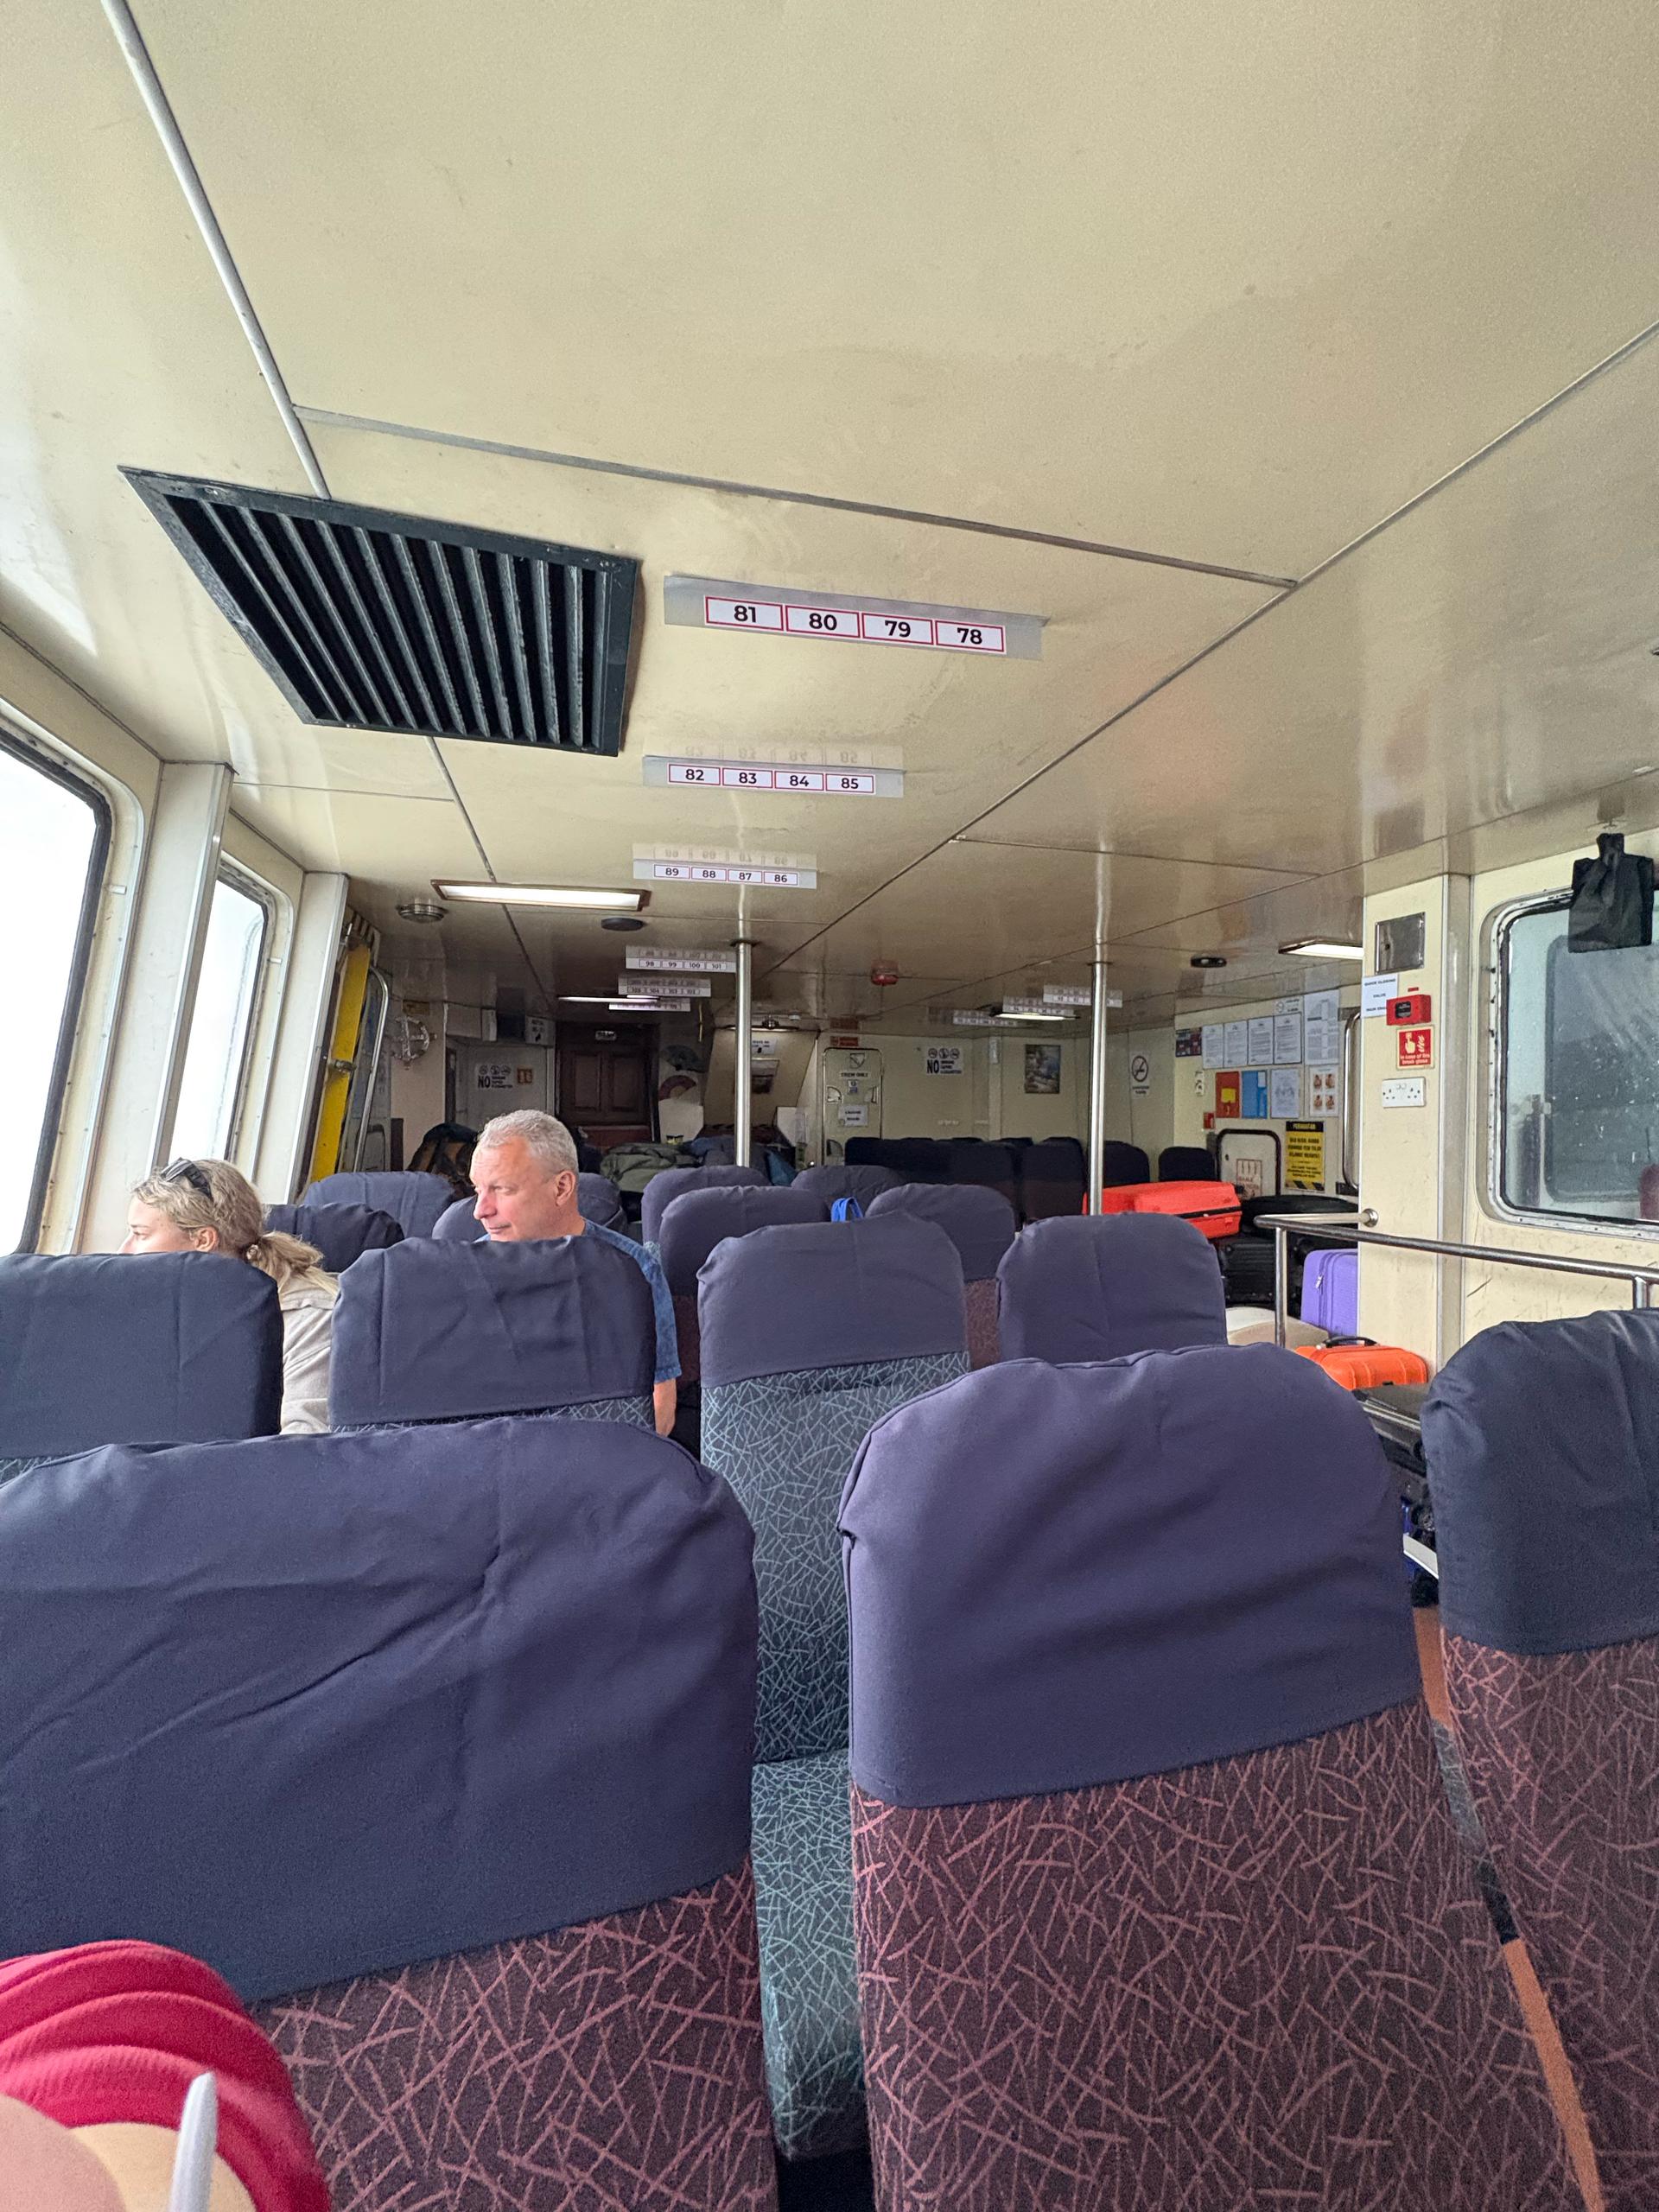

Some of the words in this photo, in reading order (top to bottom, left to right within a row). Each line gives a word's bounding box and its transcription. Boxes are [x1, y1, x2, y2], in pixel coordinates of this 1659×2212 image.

[733, 605, 758, 624] 81
[808, 613, 838, 632] 80
[884, 620, 912, 639] 79
[957, 627, 983, 645] 78
[684, 768, 705, 783] 82
[738, 772, 758, 786] 83
[789, 774, 810, 788] 84
[841, 777, 860, 791] 85
[664, 867, 680, 877] 89
[702, 869, 716, 880] 88
[738, 871, 753, 881] 87
[773, 874, 788, 884] 86
[926, 1059, 940, 1075] NO
[478, 1076, 491, 1089] NO
